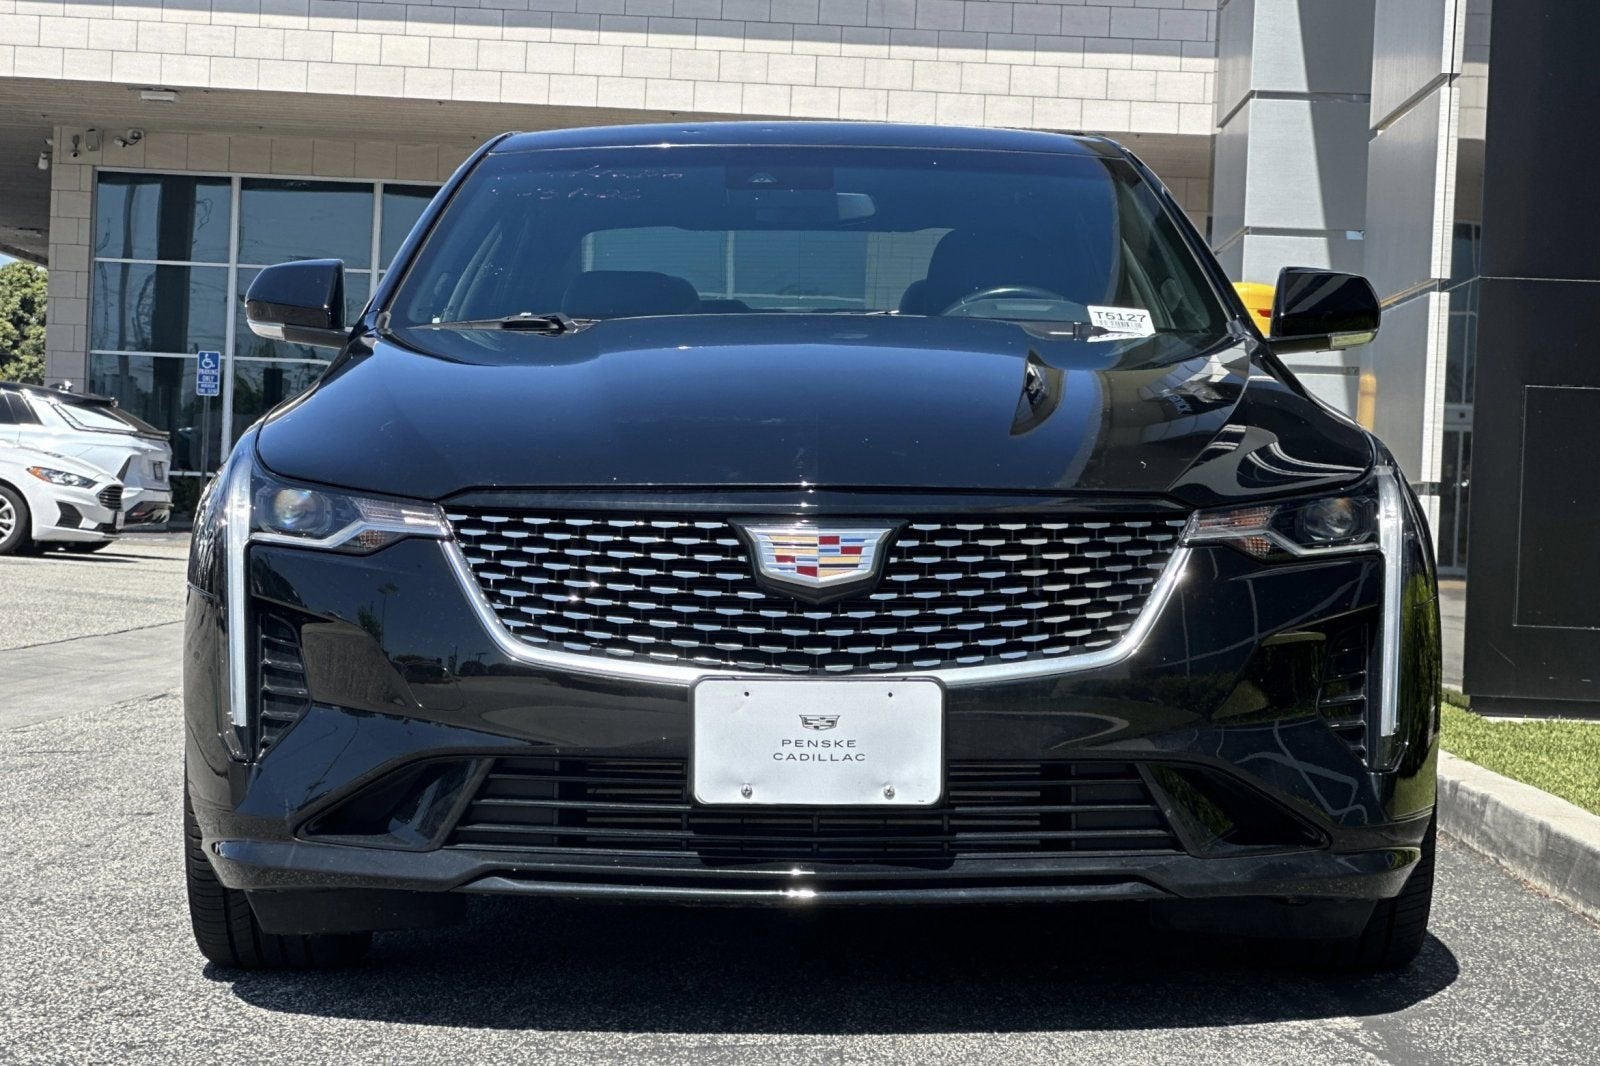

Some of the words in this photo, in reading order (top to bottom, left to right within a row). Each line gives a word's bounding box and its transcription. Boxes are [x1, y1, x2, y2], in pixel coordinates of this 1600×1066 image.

[1093, 311, 1147, 323] T5127
[781, 739, 857, 748] PENSKE
[772, 752, 866, 761] CADILLAC
